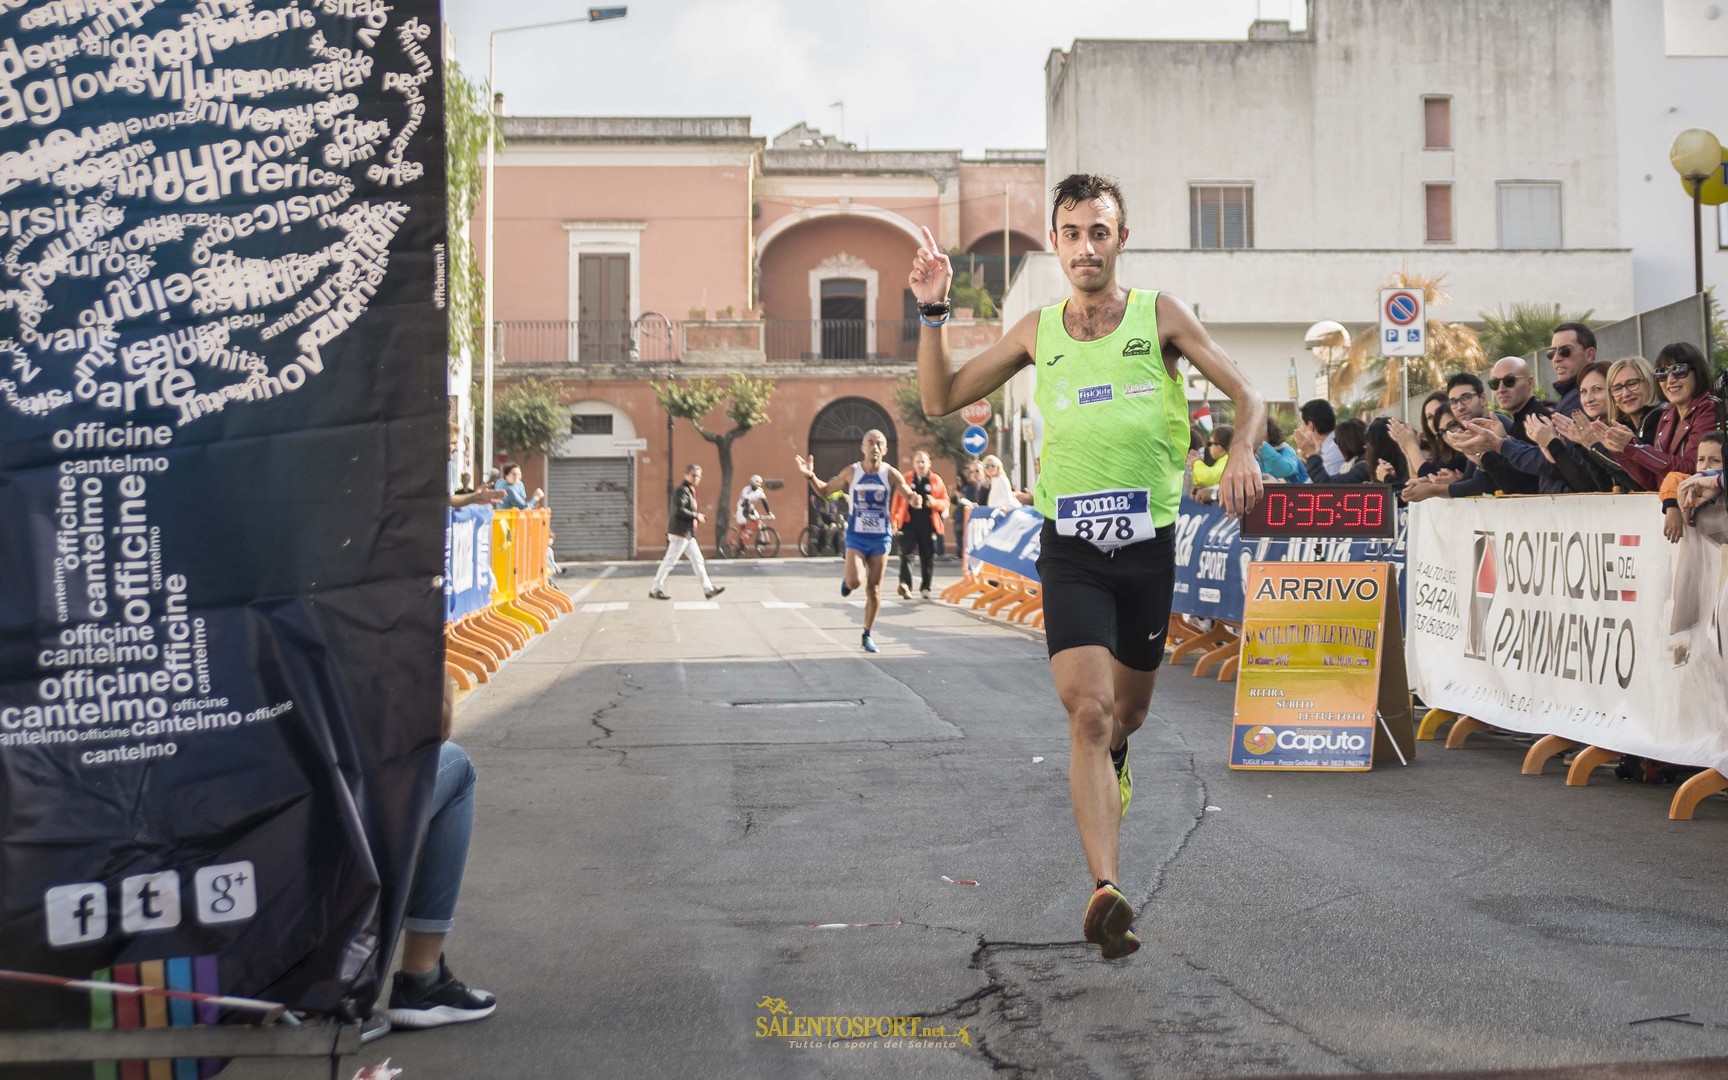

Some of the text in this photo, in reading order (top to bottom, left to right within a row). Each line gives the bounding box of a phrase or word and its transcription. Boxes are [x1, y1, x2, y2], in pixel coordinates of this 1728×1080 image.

[53, 421, 173, 449] officine
[60, 454, 169, 475] cantelmo
[56, 474, 80, 570] officine
[1267, 493, 1384, 527] 0:35:58
[1075, 516, 1135, 542] 878
[79, 476, 108, 618] cantelmo
[113, 473, 152, 624] officine
[149, 525, 162, 591] cantelmo
[1196, 550, 1229, 582] SPORT
[1503, 531, 1619, 602] BOUTIQUE
[1618, 556, 1636, 580] DEL
[1255, 577, 1380, 601] ARRIVO
[60, 622, 156, 646] officine
[160, 573, 194, 692] officine
[38, 643, 159, 667] cantelmo
[193, 617, 211, 695] cantelmo
[1491, 607, 1636, 690] PAVIMENTO
[39, 667, 172, 700] officine
[1249, 688, 1285, 698] RITIRA
[1, 695, 168, 730] cantelmo
[172, 695, 229, 714] officine
[1276, 700, 1314, 709] SUBITO
[1337, 712, 1366, 721] FOTO
[0, 727, 79, 747] antelmo
[131, 709, 243, 737] cantelmo
[1276, 730, 1366, 754] Caputo
[82, 742, 178, 766] cantelmo
